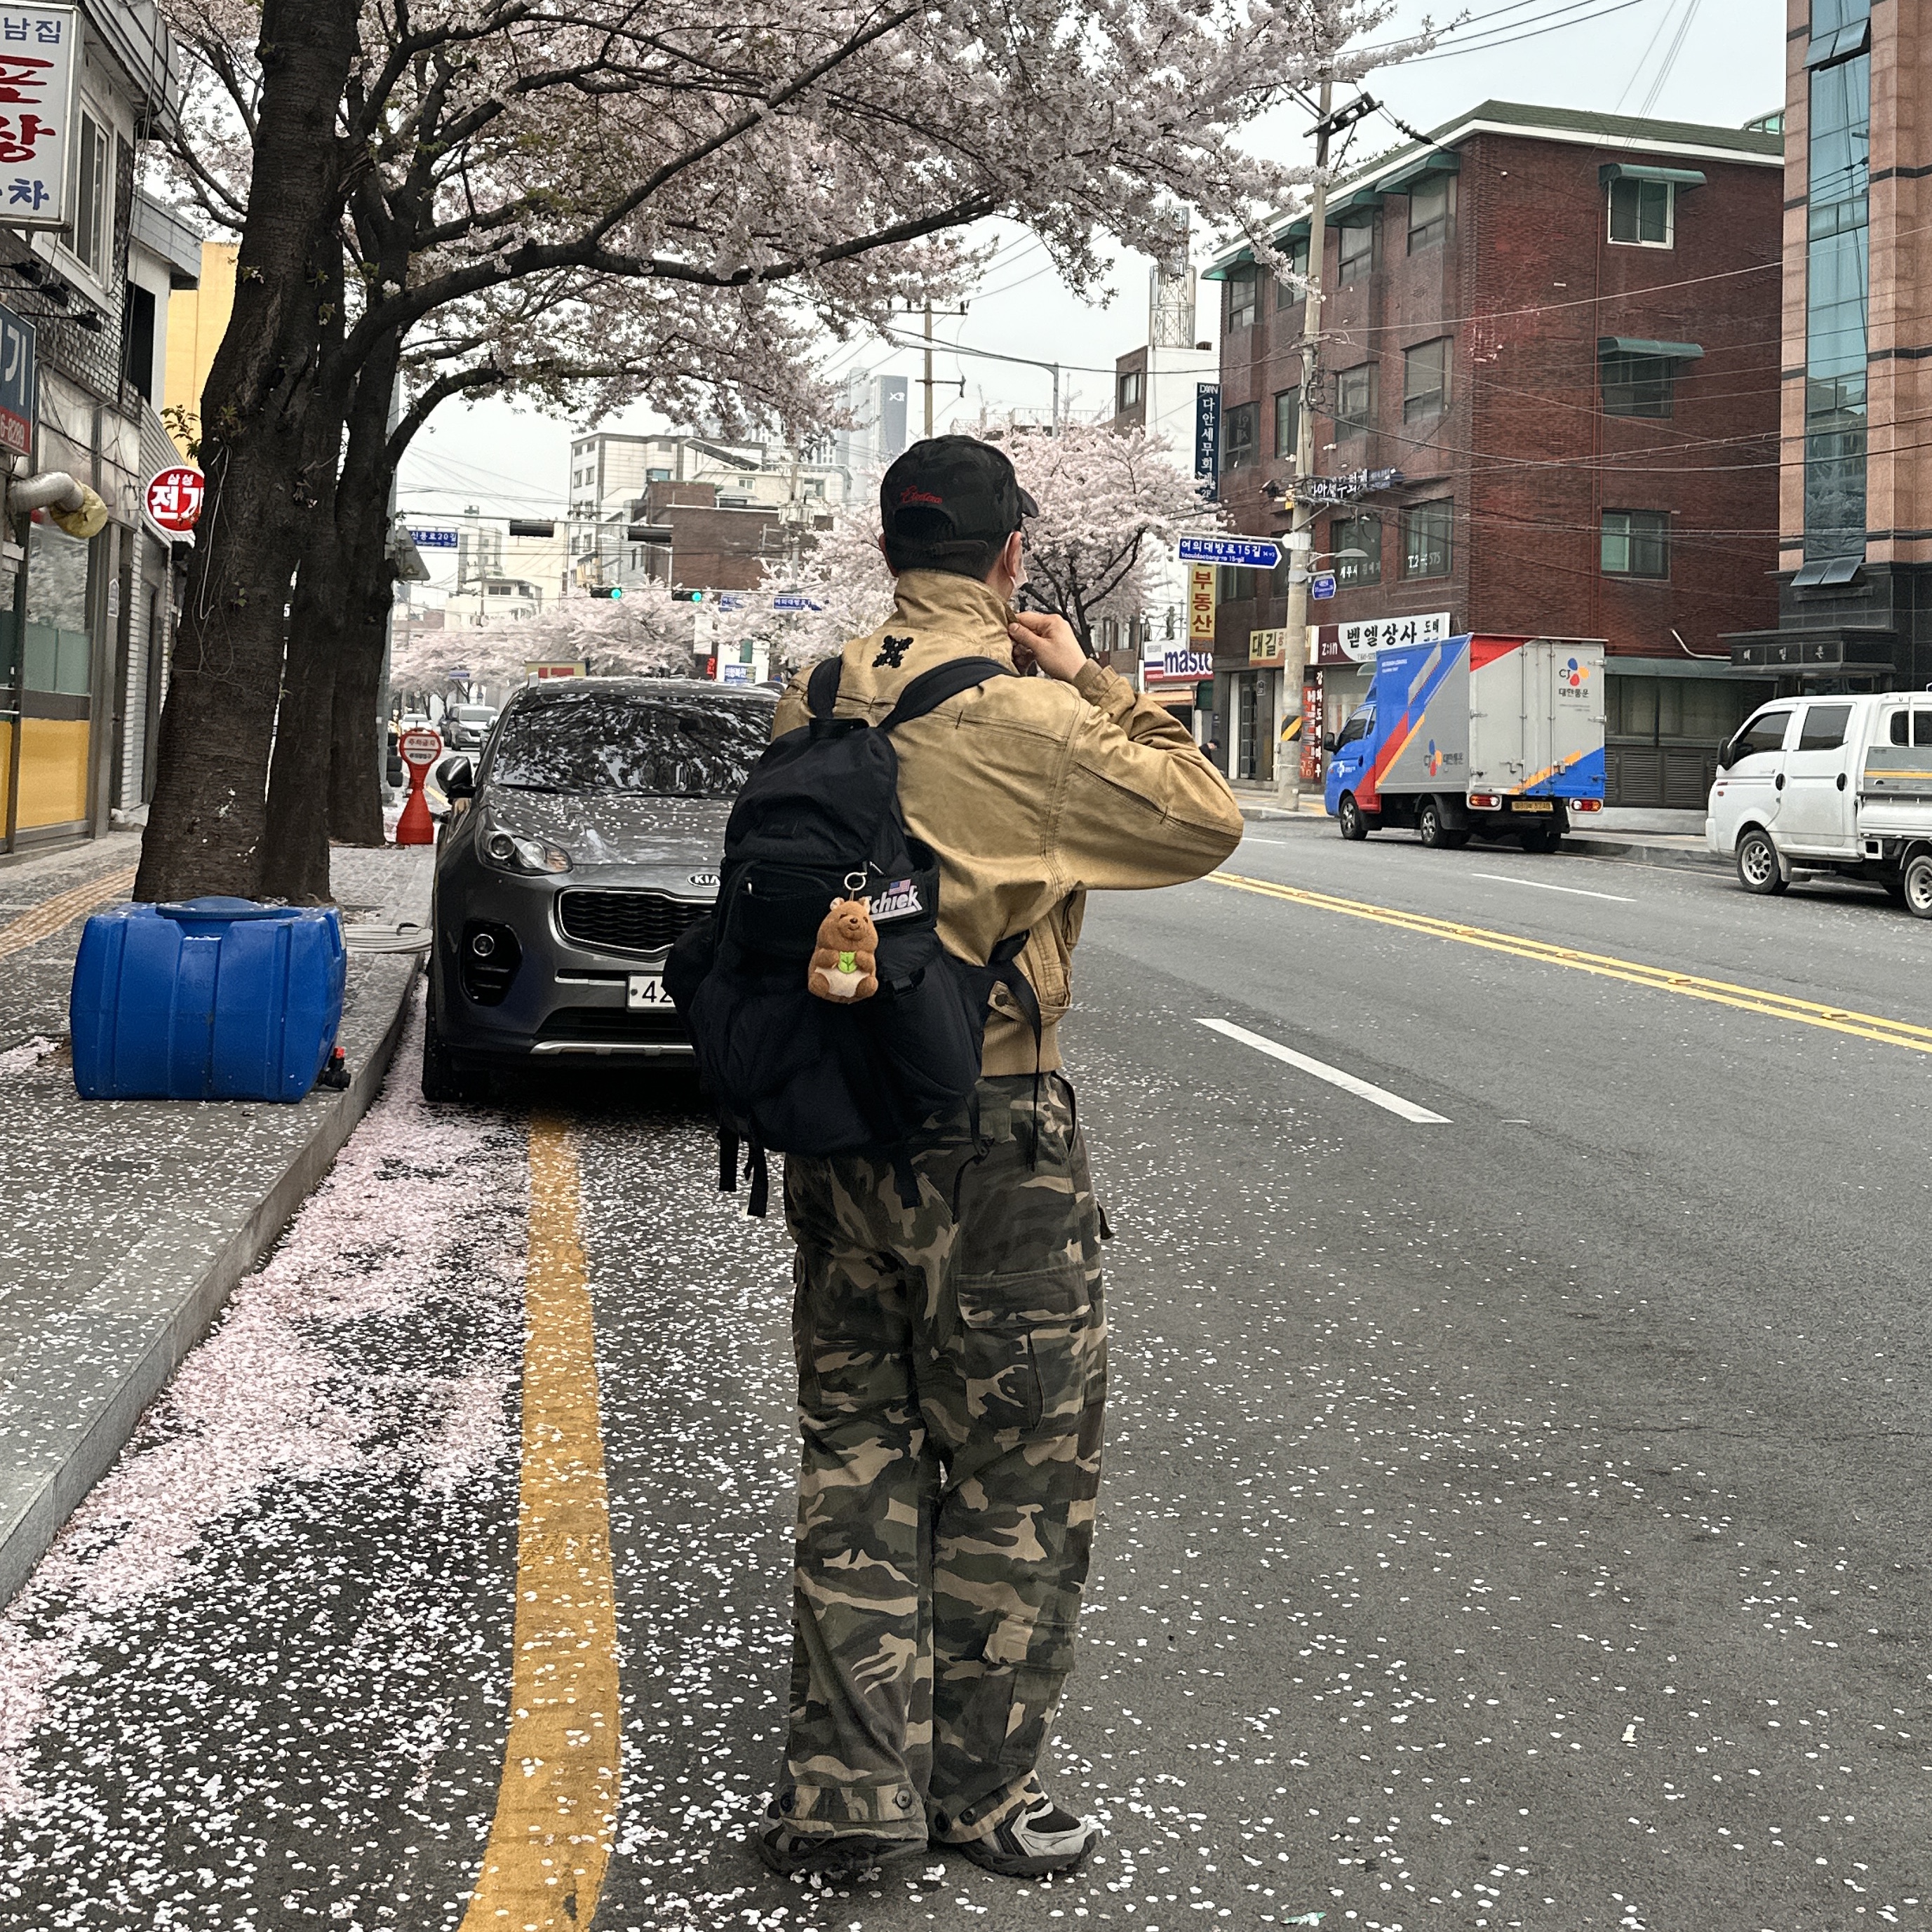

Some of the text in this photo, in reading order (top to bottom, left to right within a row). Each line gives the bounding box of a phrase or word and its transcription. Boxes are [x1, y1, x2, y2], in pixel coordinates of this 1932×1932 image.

[0, 178, 50, 210] 차
[150, 485, 204, 519] 전기
[1181, 539, 1261, 558] 여의대방로15길
[1193, 571, 1213, 633] 부동산
[1252, 631, 1277, 657] 대길
[1558, 669, 1571, 680] CJ
[1558, 687, 1589, 698] 대한통운
[695, 875, 719, 884] KIA
[868, 885, 923, 914] chiek
